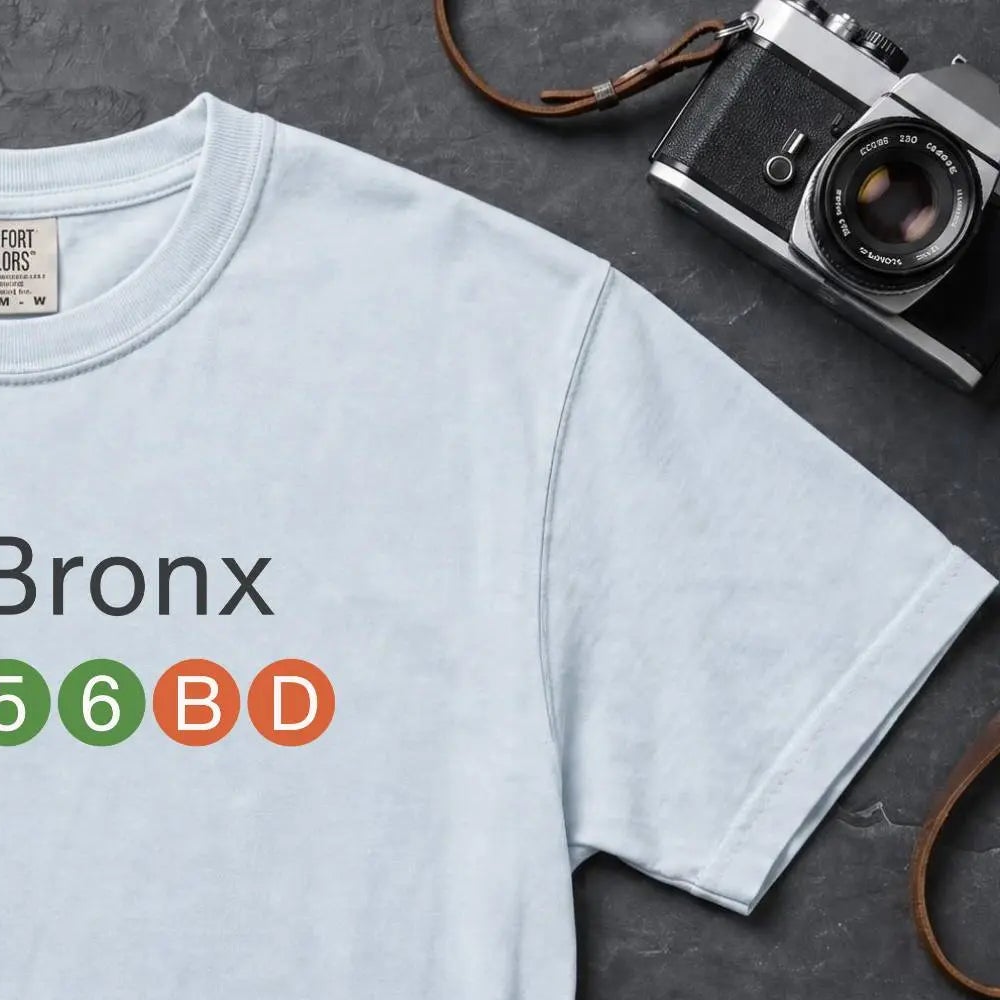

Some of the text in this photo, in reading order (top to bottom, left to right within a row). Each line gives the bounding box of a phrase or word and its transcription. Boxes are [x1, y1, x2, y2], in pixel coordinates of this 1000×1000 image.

[33, 296, 46, 306] W
[83, 675, 120, 731] 6
[178, 676, 221, 730] B
[274, 676, 317, 730] D
